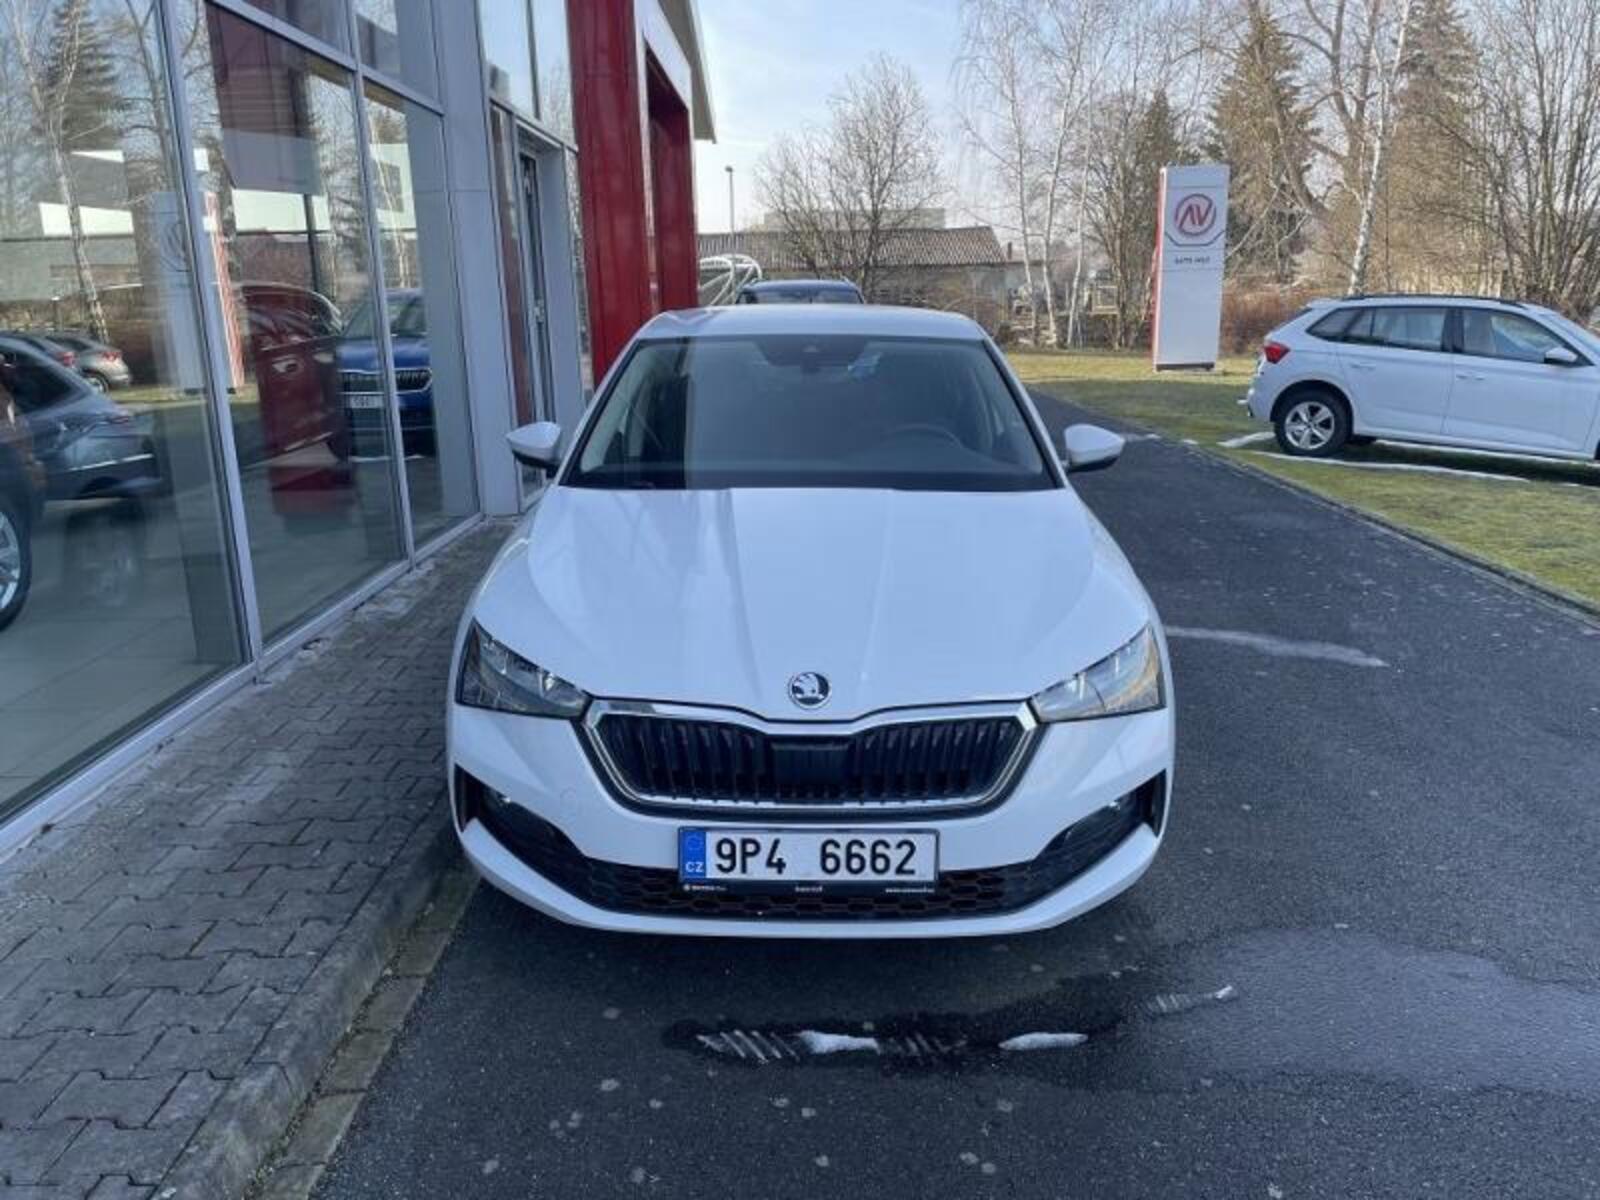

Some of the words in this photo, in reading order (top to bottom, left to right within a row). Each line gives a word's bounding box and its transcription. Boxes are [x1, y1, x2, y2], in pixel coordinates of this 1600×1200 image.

[685, 862, 705, 873] CZ
[715, 838, 787, 875] 9P4
[820, 839, 917, 876] 6662
